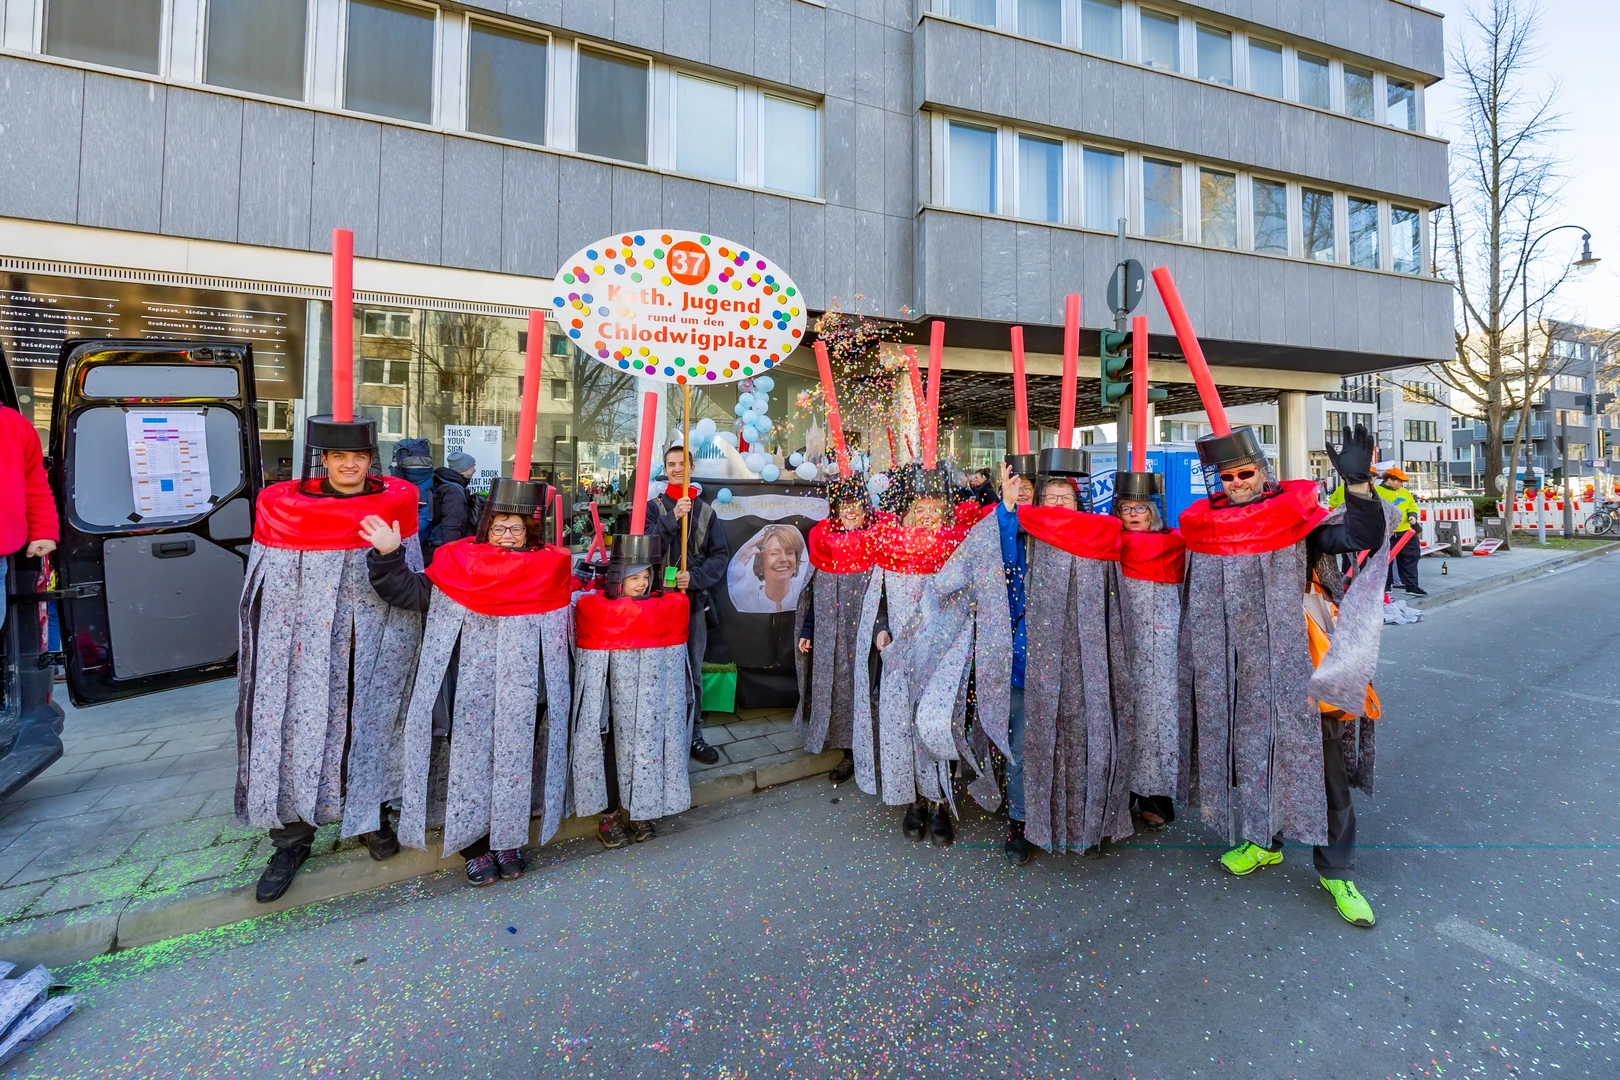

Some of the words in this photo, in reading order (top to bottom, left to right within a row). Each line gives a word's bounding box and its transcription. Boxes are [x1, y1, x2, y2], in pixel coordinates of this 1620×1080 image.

[671, 250, 706, 278] 37
[10, 295, 36, 303] farbig
[682, 292, 761, 315] Jugend
[43, 313, 93, 322] Hausarbeiten
[647, 313, 676, 323] rund
[681, 317, 699, 325] um
[703, 317, 725, 327] den
[228, 327, 250, 335] farbig
[598, 322, 768, 352] Chlodwigplatz
[447, 429, 463, 437] THIS
[464, 429, 471, 437] IS
[447, 437, 466, 445] YOUR
[447, 445, 463, 453] SIGN
[481, 470, 499, 478] BOOK
[469, 478, 481, 486] HAT
[754, 501, 788, 512] super
